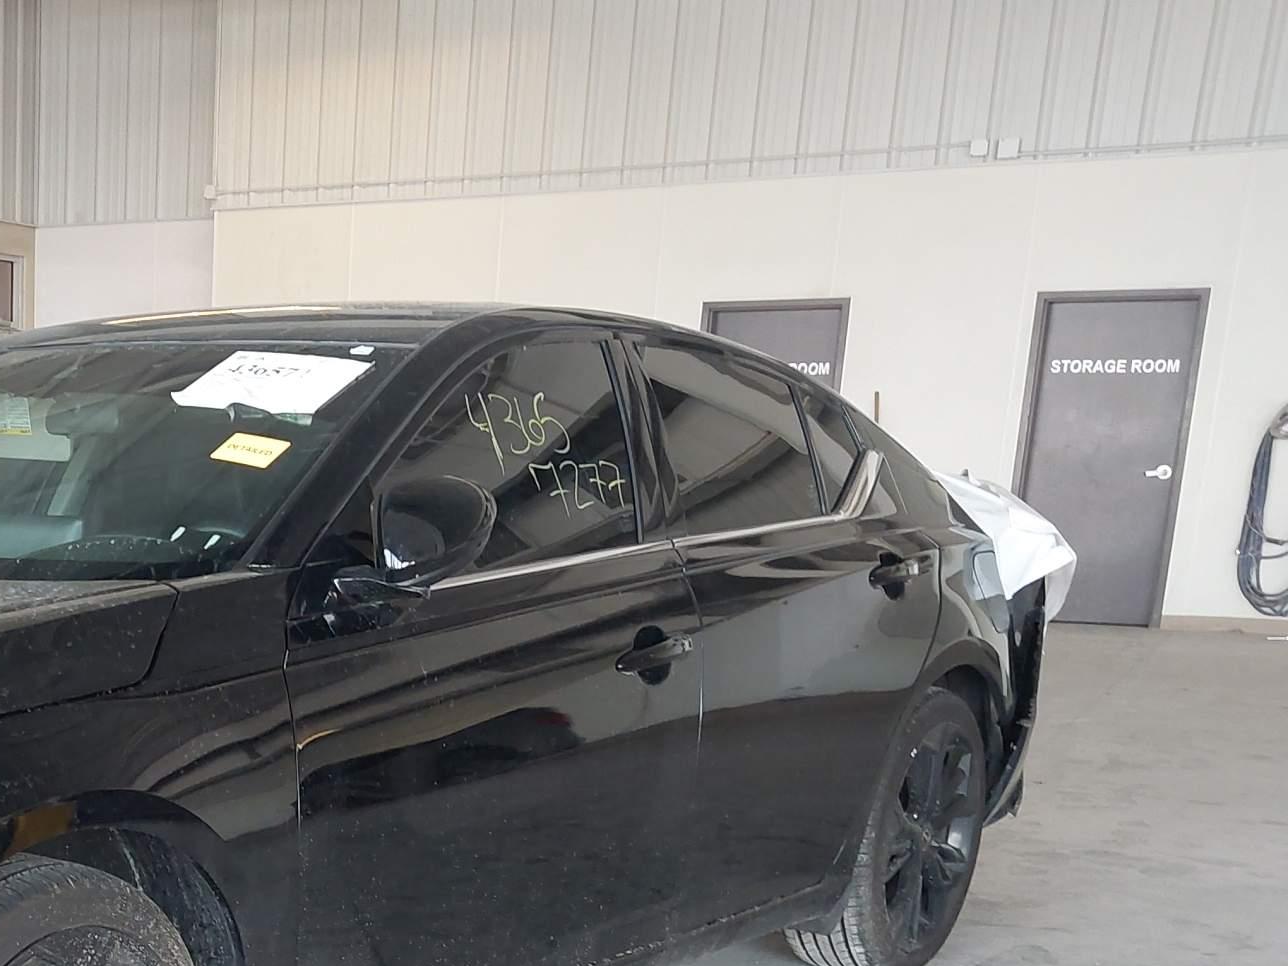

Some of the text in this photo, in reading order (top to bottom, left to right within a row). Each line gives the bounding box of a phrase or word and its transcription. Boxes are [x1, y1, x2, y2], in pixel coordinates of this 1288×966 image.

[1049, 358, 1181, 374] STORAGE ROOM
[464, 391, 571, 479] 4365
[527, 459, 627, 521] 7277
